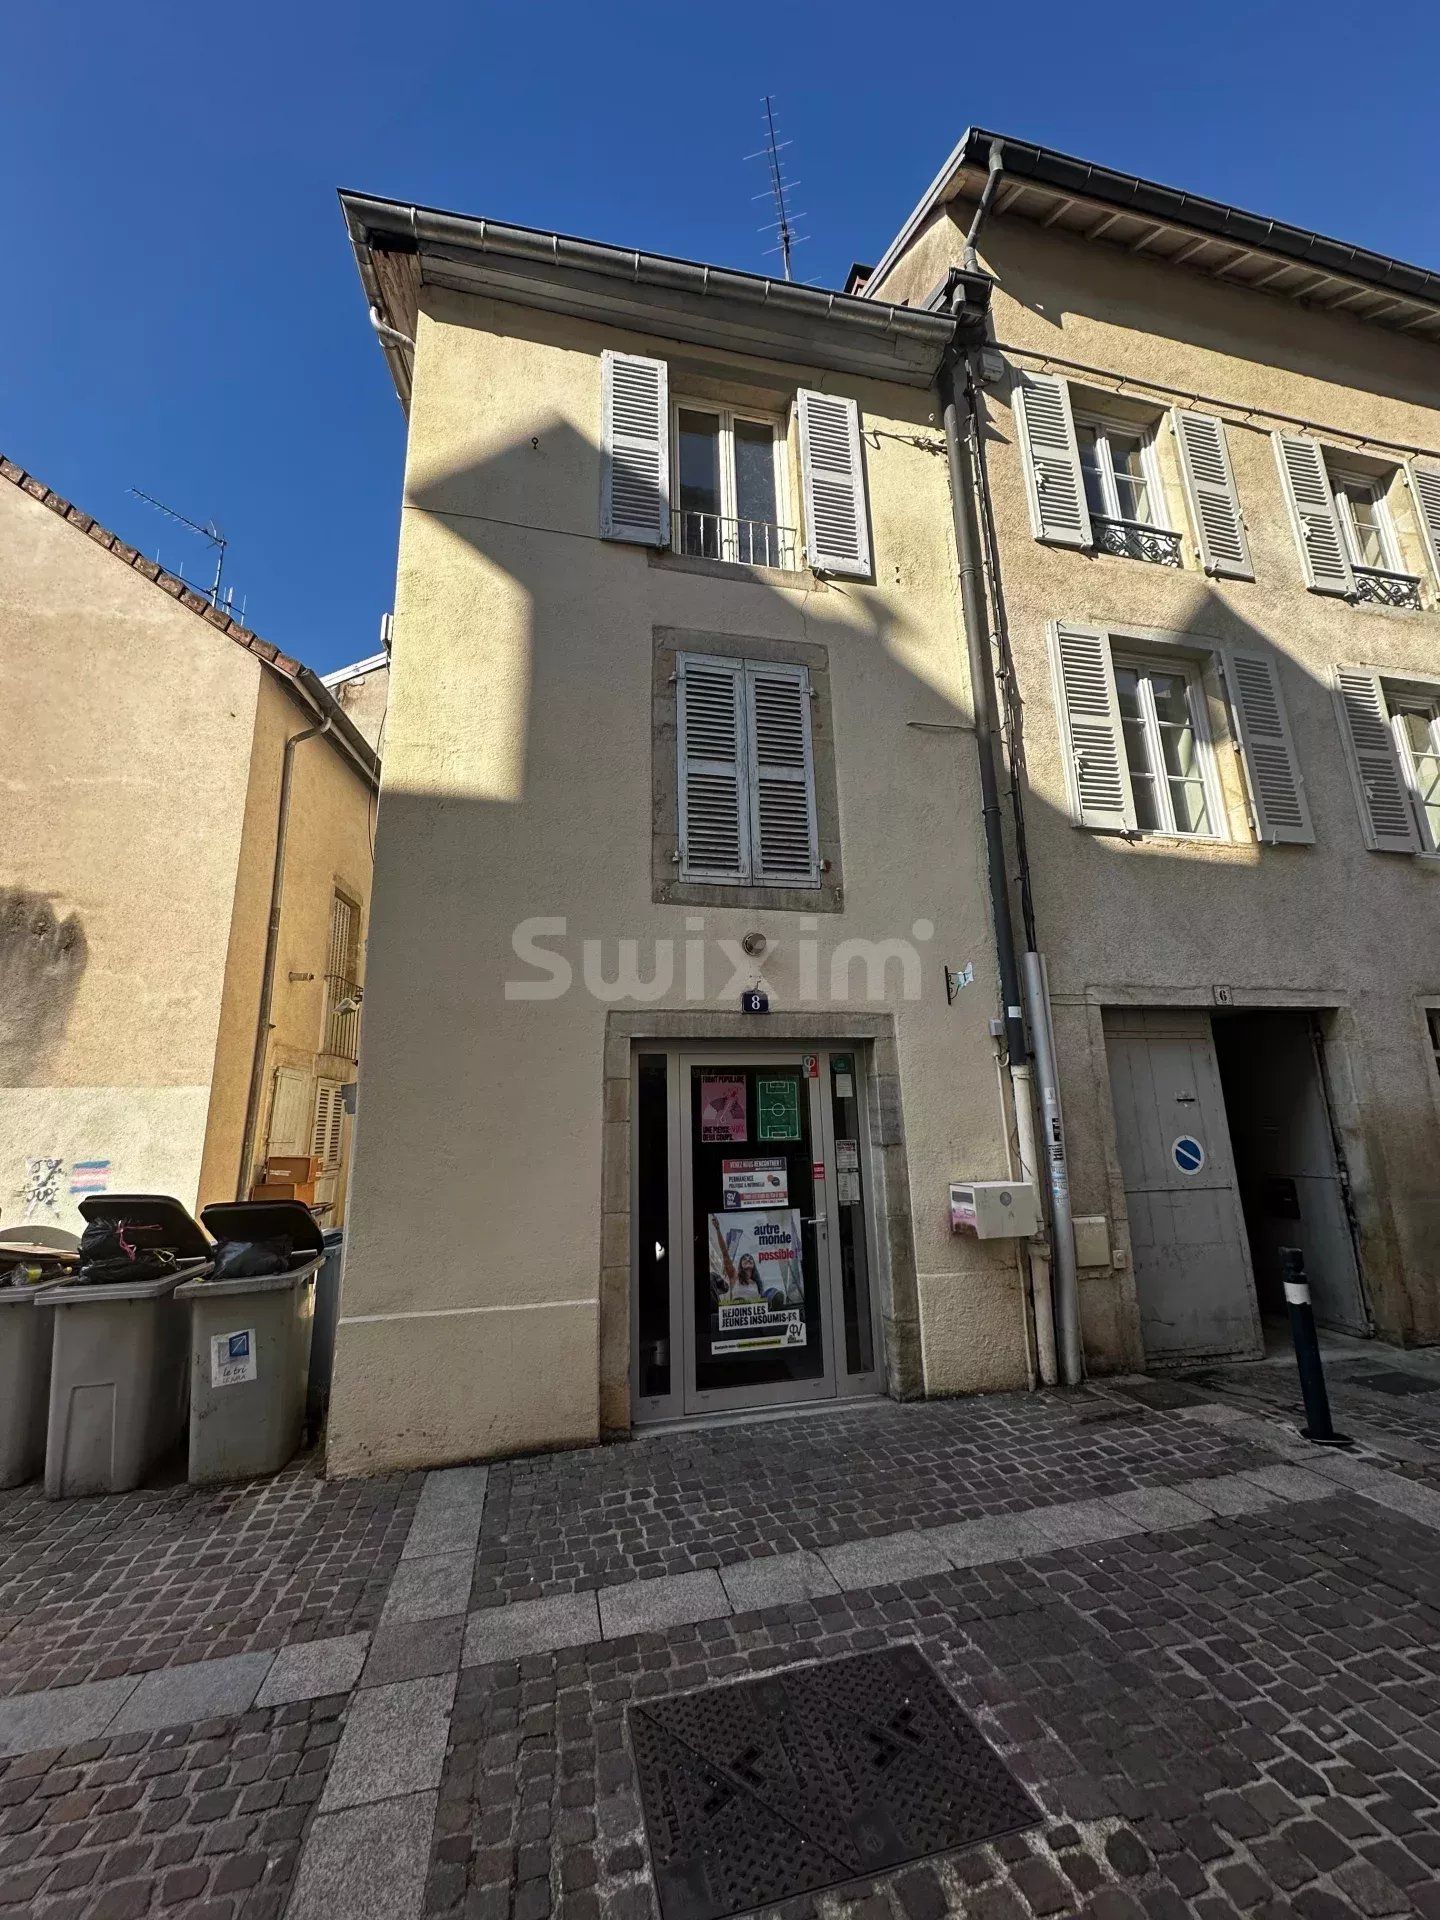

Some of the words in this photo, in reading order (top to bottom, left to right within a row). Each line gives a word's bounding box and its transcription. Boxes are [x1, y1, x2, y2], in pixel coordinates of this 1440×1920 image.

[751, 995, 761, 1010] 8
[1219, 989, 1228, 1002] 6
[754, 1223, 780, 1236] autre
[758, 1231, 792, 1246] monde
[758, 1248, 794, 1263] possible
[722, 1308, 752, 1319] REJOINS
[753, 1305, 766, 1316] LES
[722, 1316, 748, 1328] JEUNES
